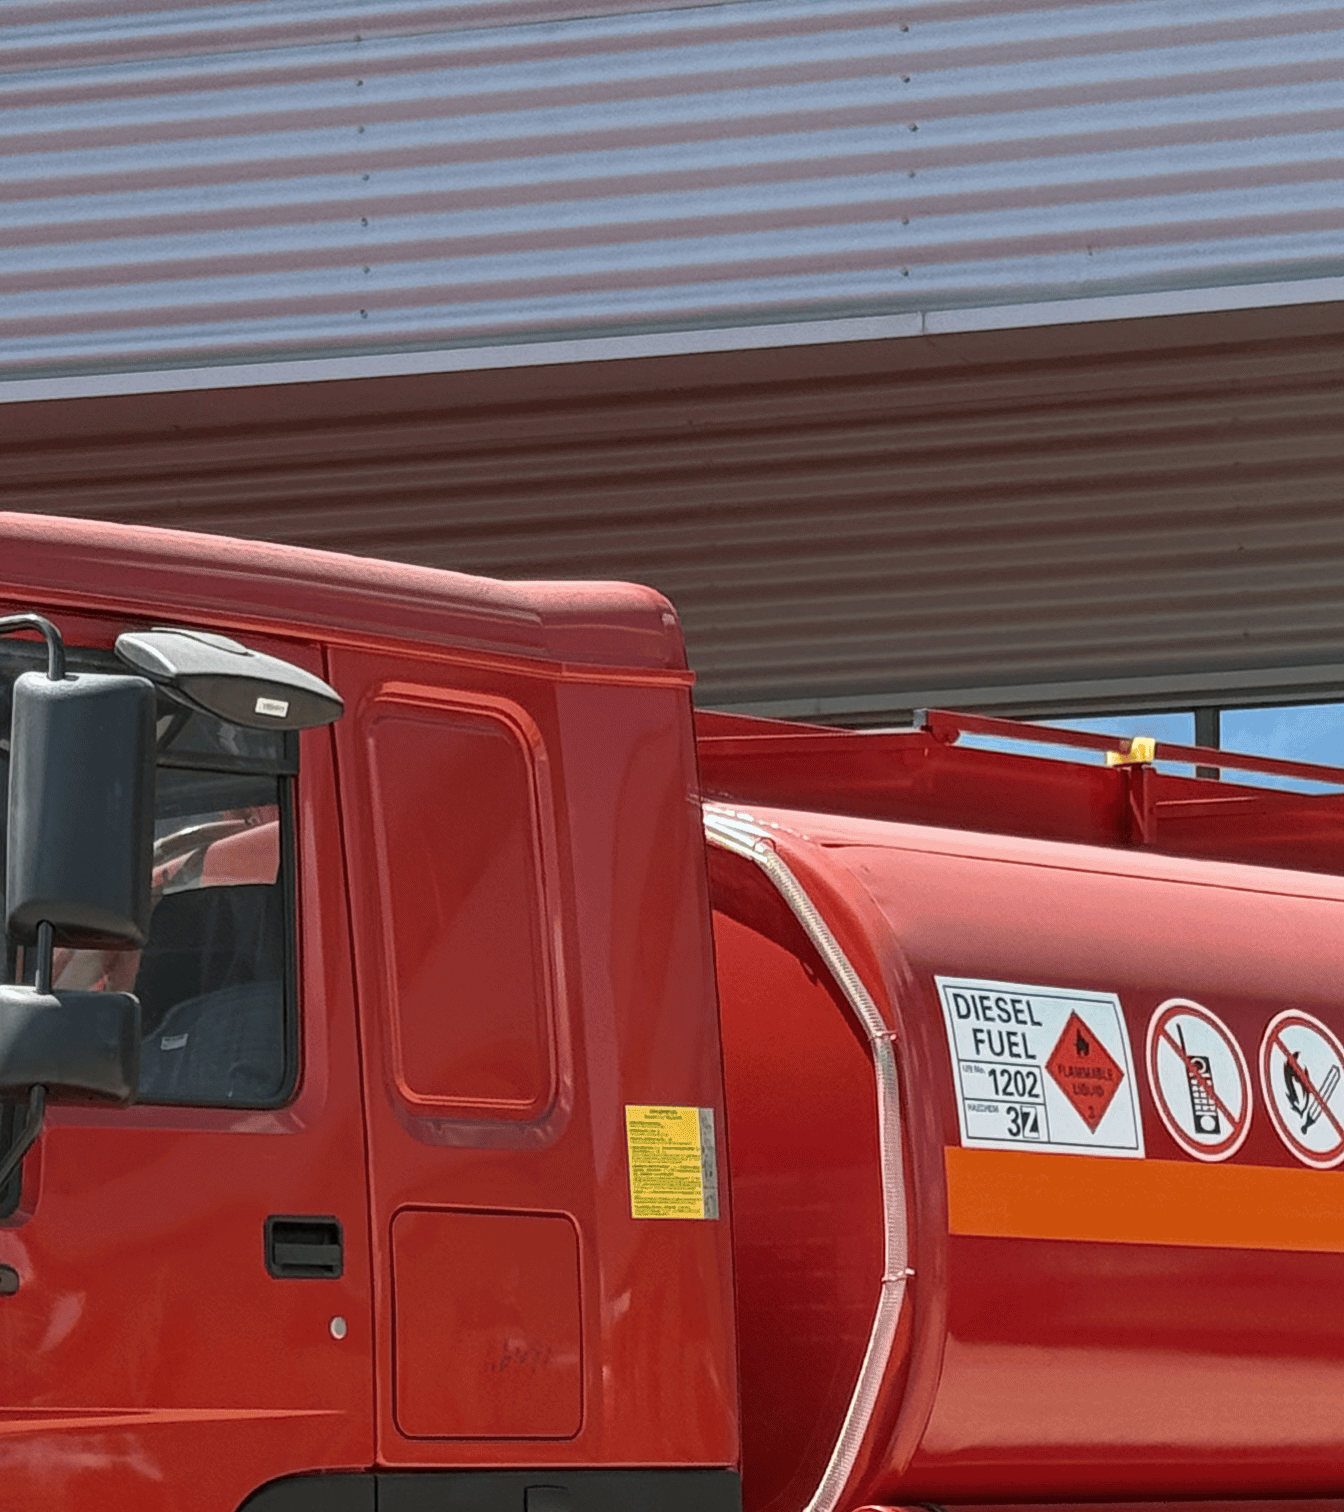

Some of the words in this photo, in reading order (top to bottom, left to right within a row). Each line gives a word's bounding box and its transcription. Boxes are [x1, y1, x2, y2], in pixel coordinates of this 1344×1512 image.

[952, 992, 1043, 1027] DIESEL
[972, 1028, 1037, 1060] FUEL
[989, 1068, 1040, 1099] 1202
